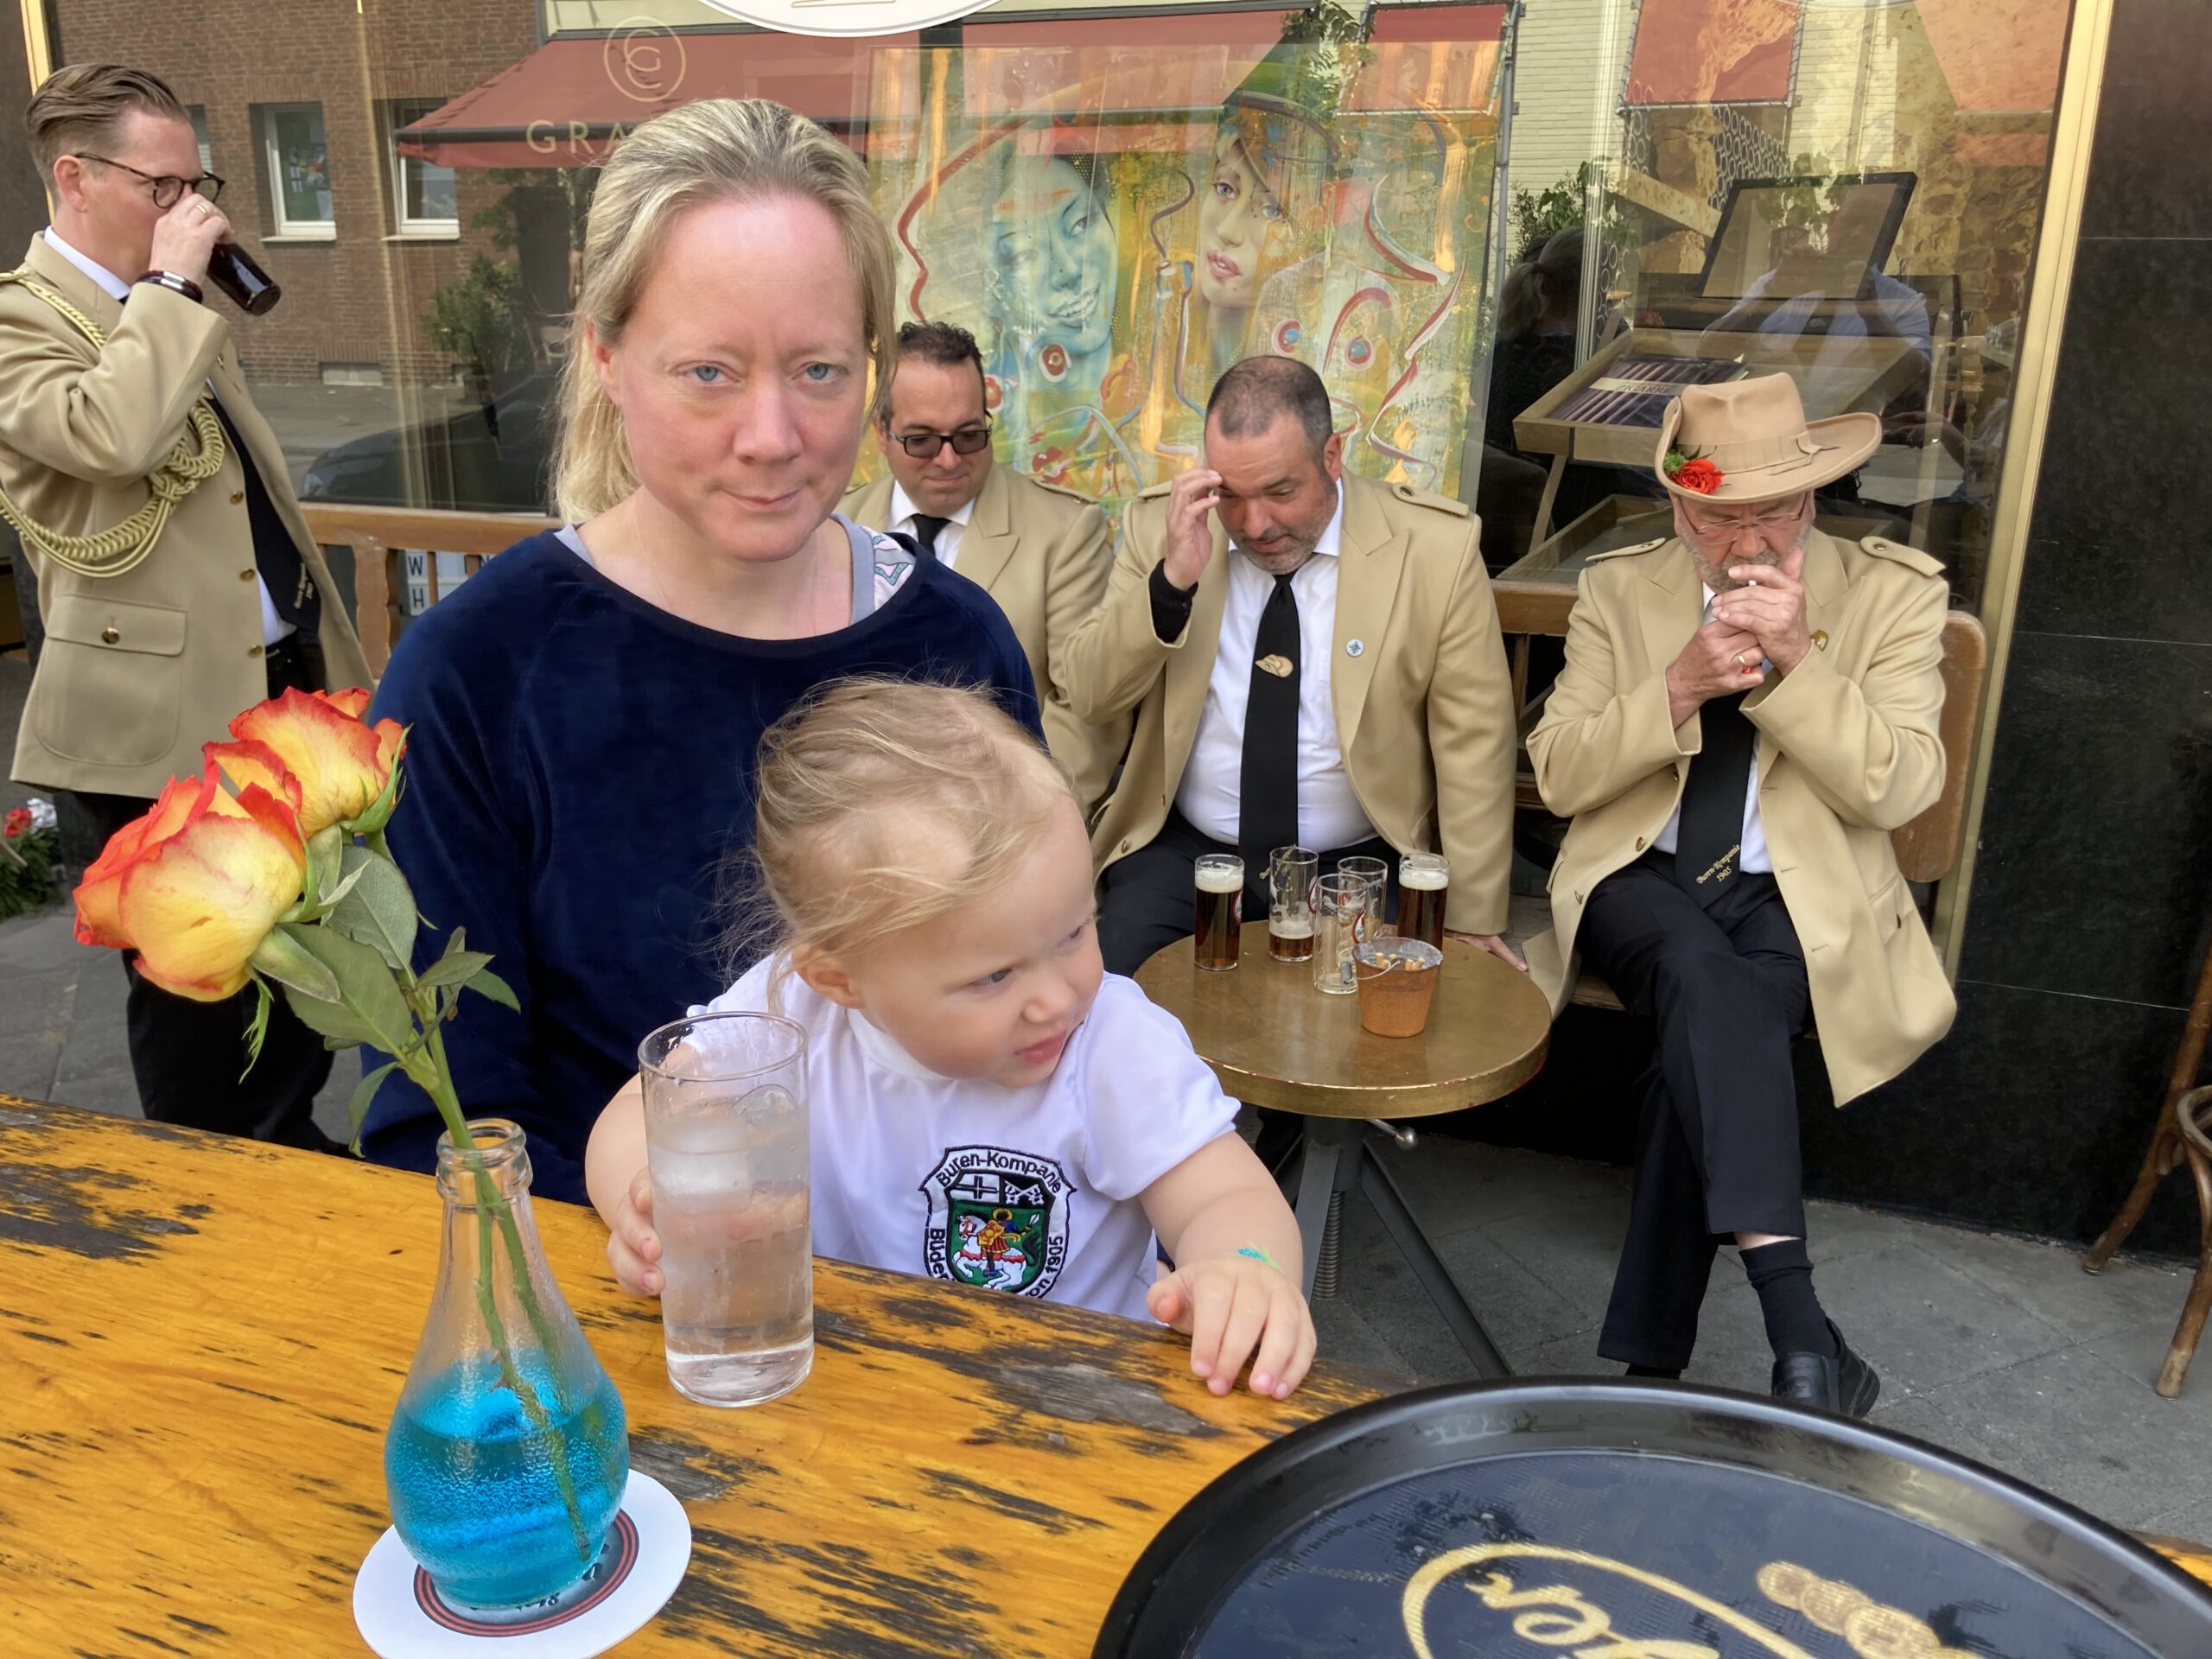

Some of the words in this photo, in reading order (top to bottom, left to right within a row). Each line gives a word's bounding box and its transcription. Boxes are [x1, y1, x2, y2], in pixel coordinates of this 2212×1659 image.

[1716, 866, 1732, 882] 1905
[936, 1150, 1061, 1194] Buren-Kompanie
[1026, 1278, 1050, 1297] on
[1046, 1236, 1064, 1273] 1905
